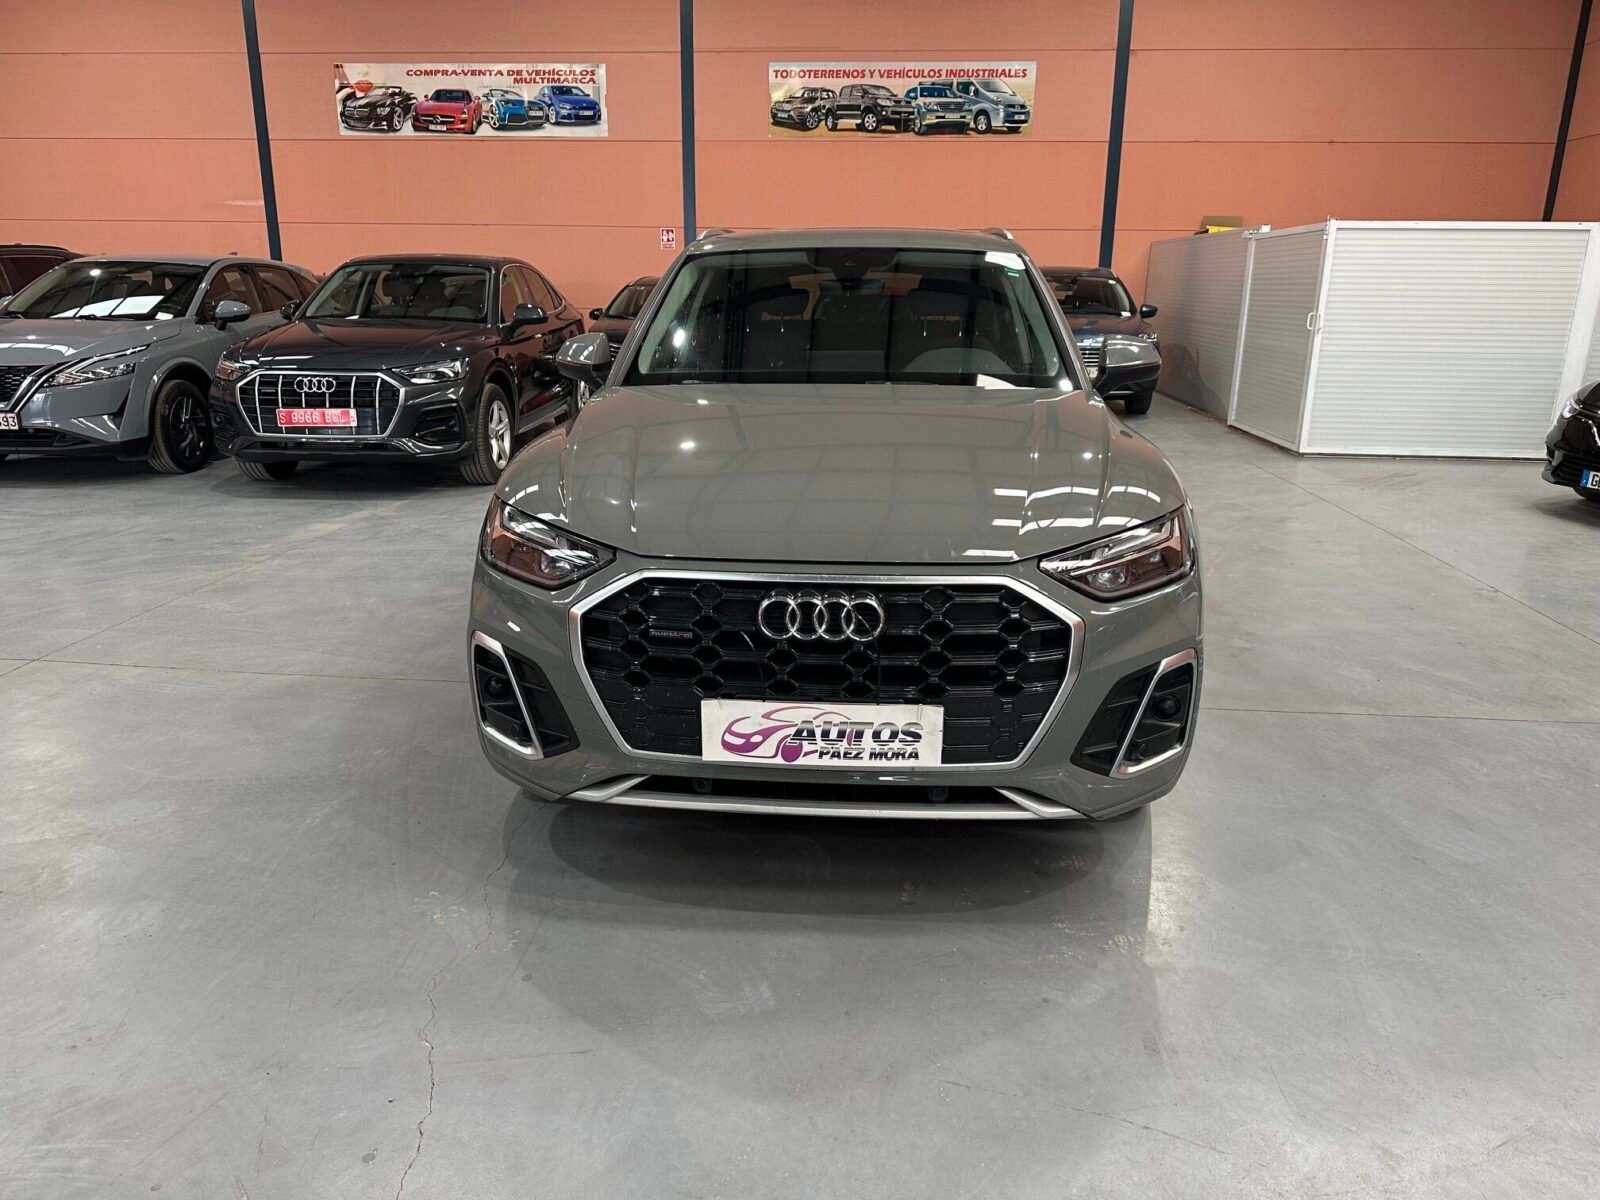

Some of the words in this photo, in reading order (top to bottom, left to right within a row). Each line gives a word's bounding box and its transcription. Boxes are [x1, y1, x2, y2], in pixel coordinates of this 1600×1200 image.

[405, 69, 504, 77] COMPRA-VENTA
[506, 69, 523, 77] DE
[526, 68, 596, 77] VEHÍCULOS
[773, 69, 866, 79] TODOTERRENOS
[867, 69, 876, 79] Y
[878, 67, 942, 79] VEHÍCULOS
[945, 68, 1028, 79] INDUSTRIALES
[513, 77, 597, 85] MULTIMARCA
[0, 416, 17, 427] 93
[787, 720, 924, 746] AUTOS
[869, 747, 920, 761] MORA
